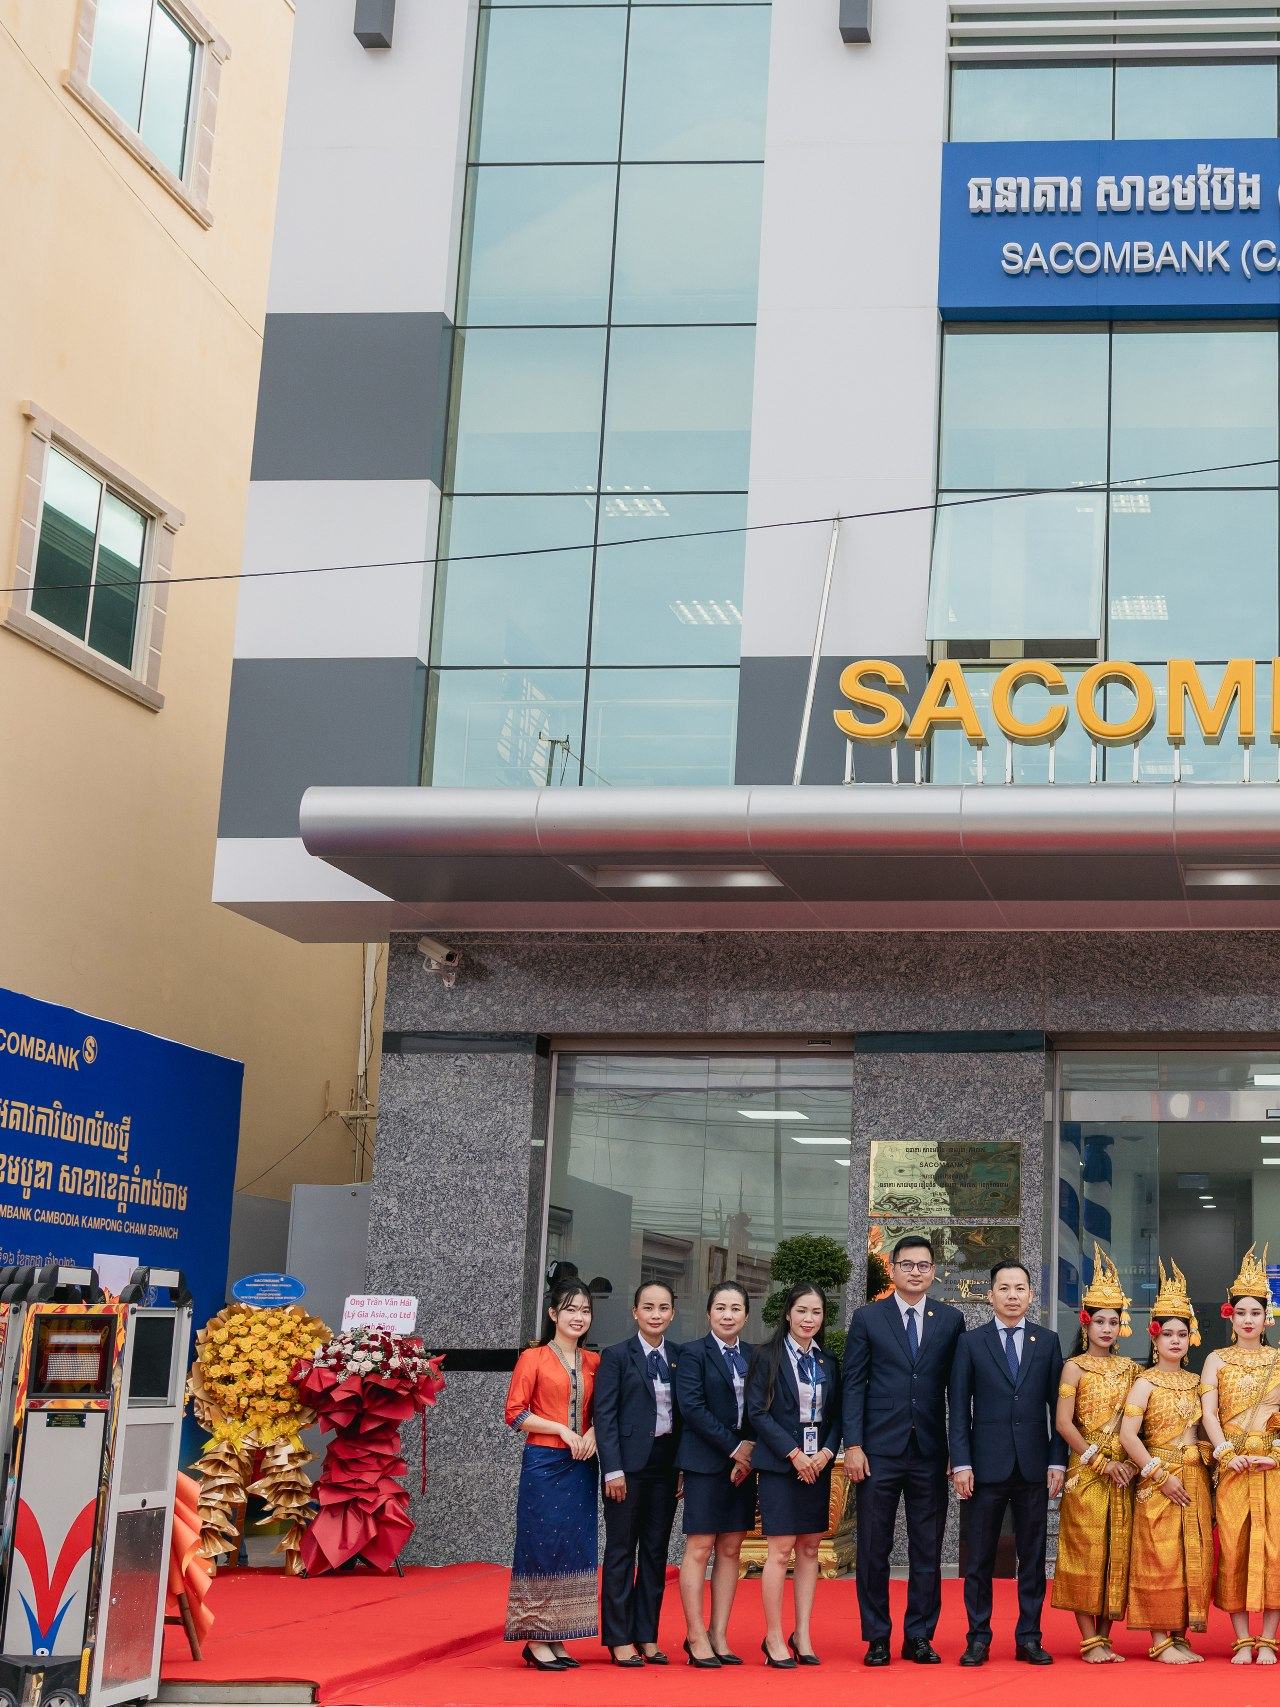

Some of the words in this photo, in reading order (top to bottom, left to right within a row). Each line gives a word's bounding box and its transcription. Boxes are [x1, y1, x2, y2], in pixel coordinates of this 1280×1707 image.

[967, 177, 1082, 213] ធនាគារ
[1001, 240, 1230, 274] SACOMBANK
[34, 1209, 79, 1228] CAMBODIA
[81, 1215, 122, 1233] KAMPONG
[124, 1221, 147, 1236] CHAM
[148, 1224, 179, 1240] BRANCH
